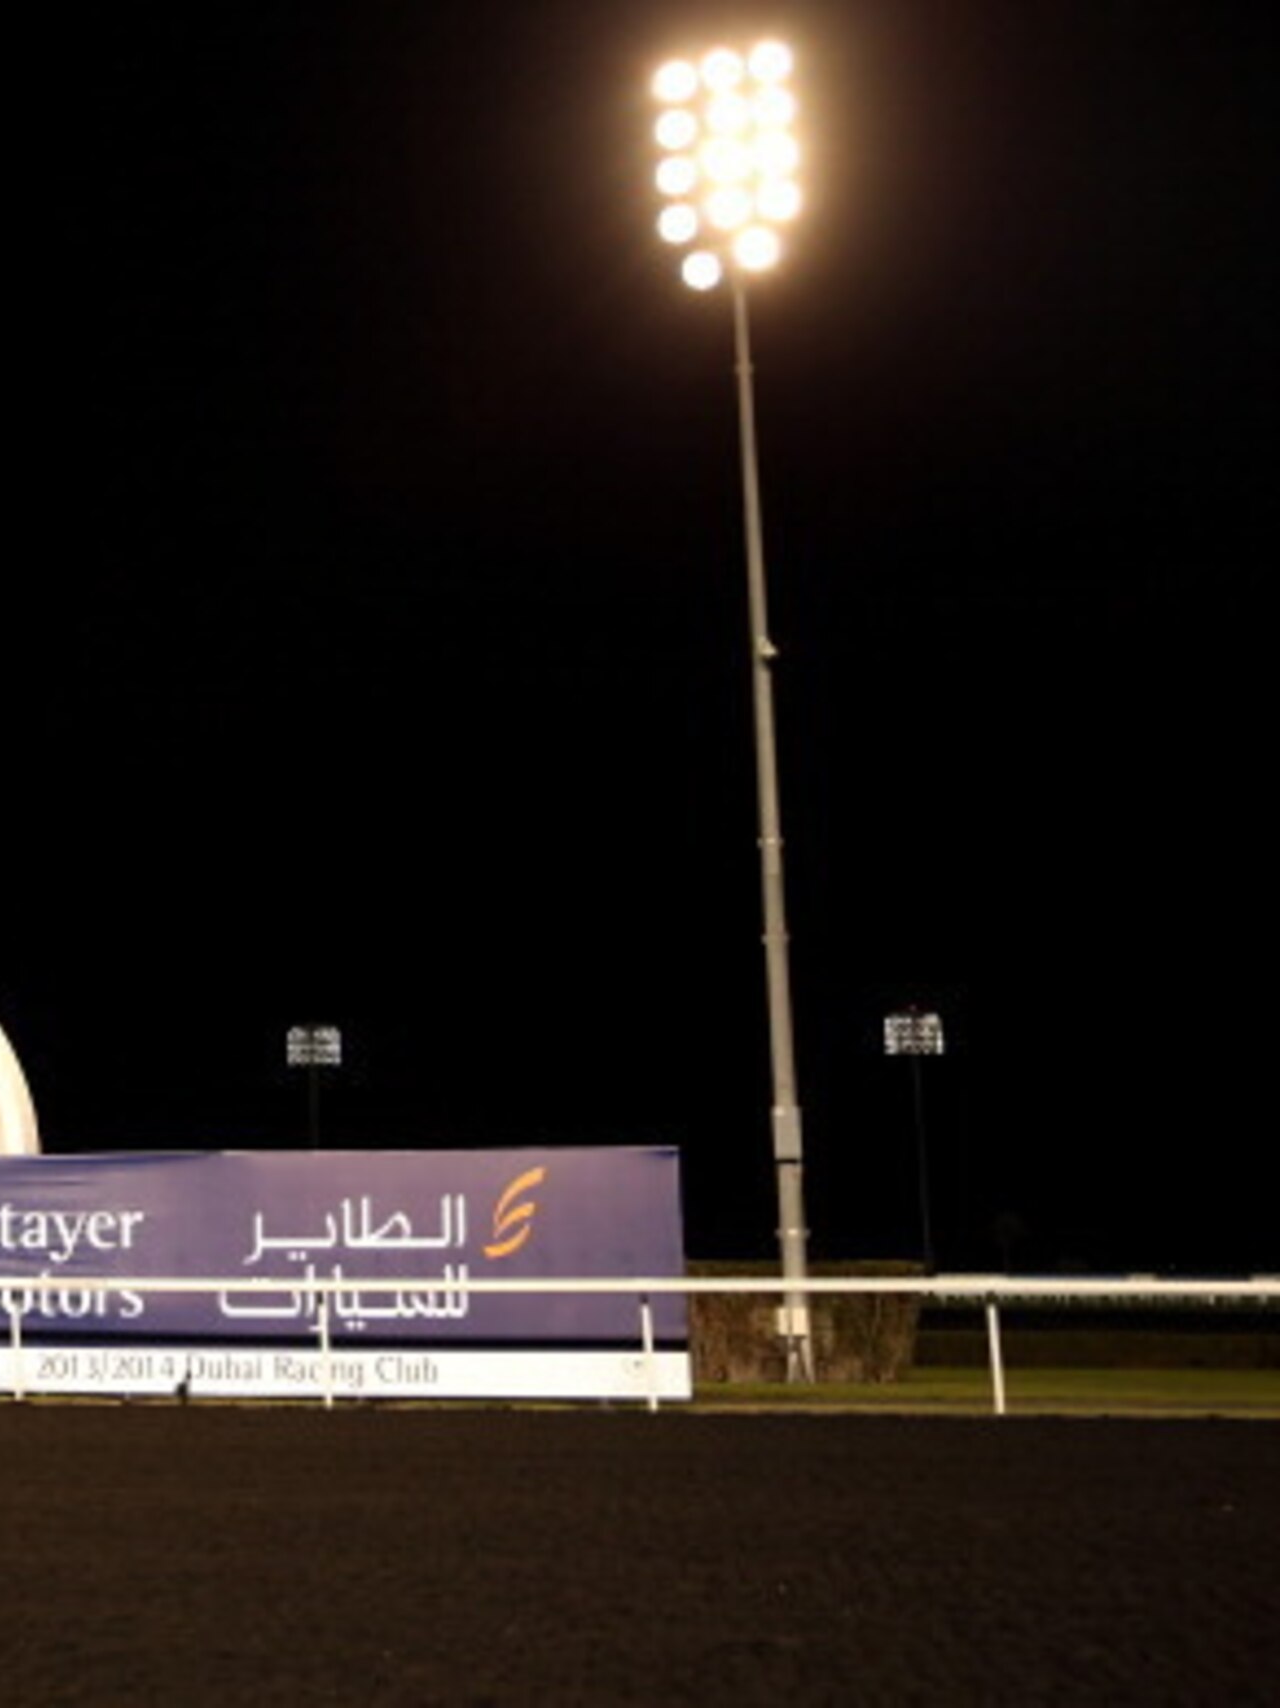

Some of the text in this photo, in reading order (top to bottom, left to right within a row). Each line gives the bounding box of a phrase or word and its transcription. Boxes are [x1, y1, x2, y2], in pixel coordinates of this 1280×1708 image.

[36, 1353, 175, 1381] 2013/2014
[186, 1354, 261, 1380] Dubai
[375, 1356, 439, 1383] Club
